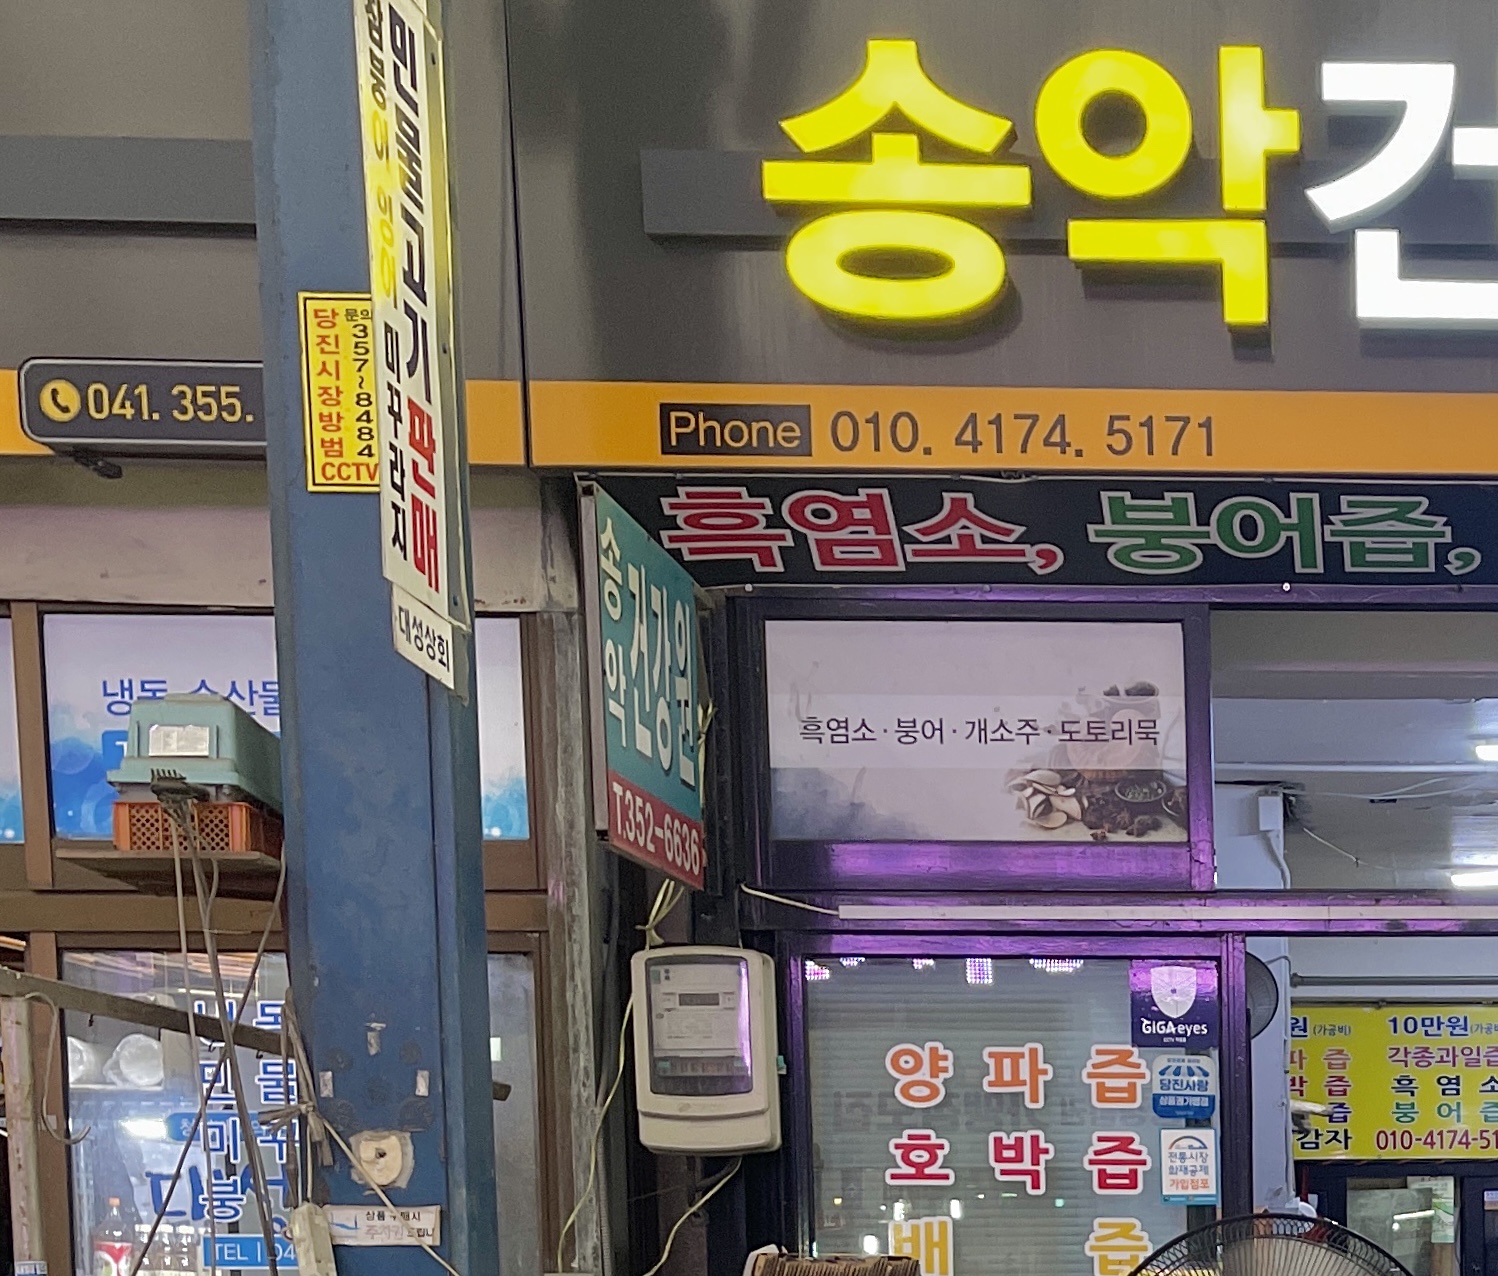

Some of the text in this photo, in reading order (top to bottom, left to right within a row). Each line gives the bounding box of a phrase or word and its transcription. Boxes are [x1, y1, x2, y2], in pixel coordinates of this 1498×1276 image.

[87, 381, 255, 423] 041. 355.
[384, 321, 408, 561] 미꾸라지
[669, 412, 1216, 457] Phone 010. 4174. 5171
[321, 462, 379, 482] CCTV
[408, 395, 440, 595] 판매
[659, 486, 1065, 574] 흑염소,
[1087, 490, 1481, 576] 붕어즙,
[398, 605, 451, 673] 대성상회
[627, 562, 697, 787] 건강원
[799, 716, 1160, 746] 흑염소 붕어 개소주 도토리묵
[1388, 1016, 1469, 1037] 10만원
